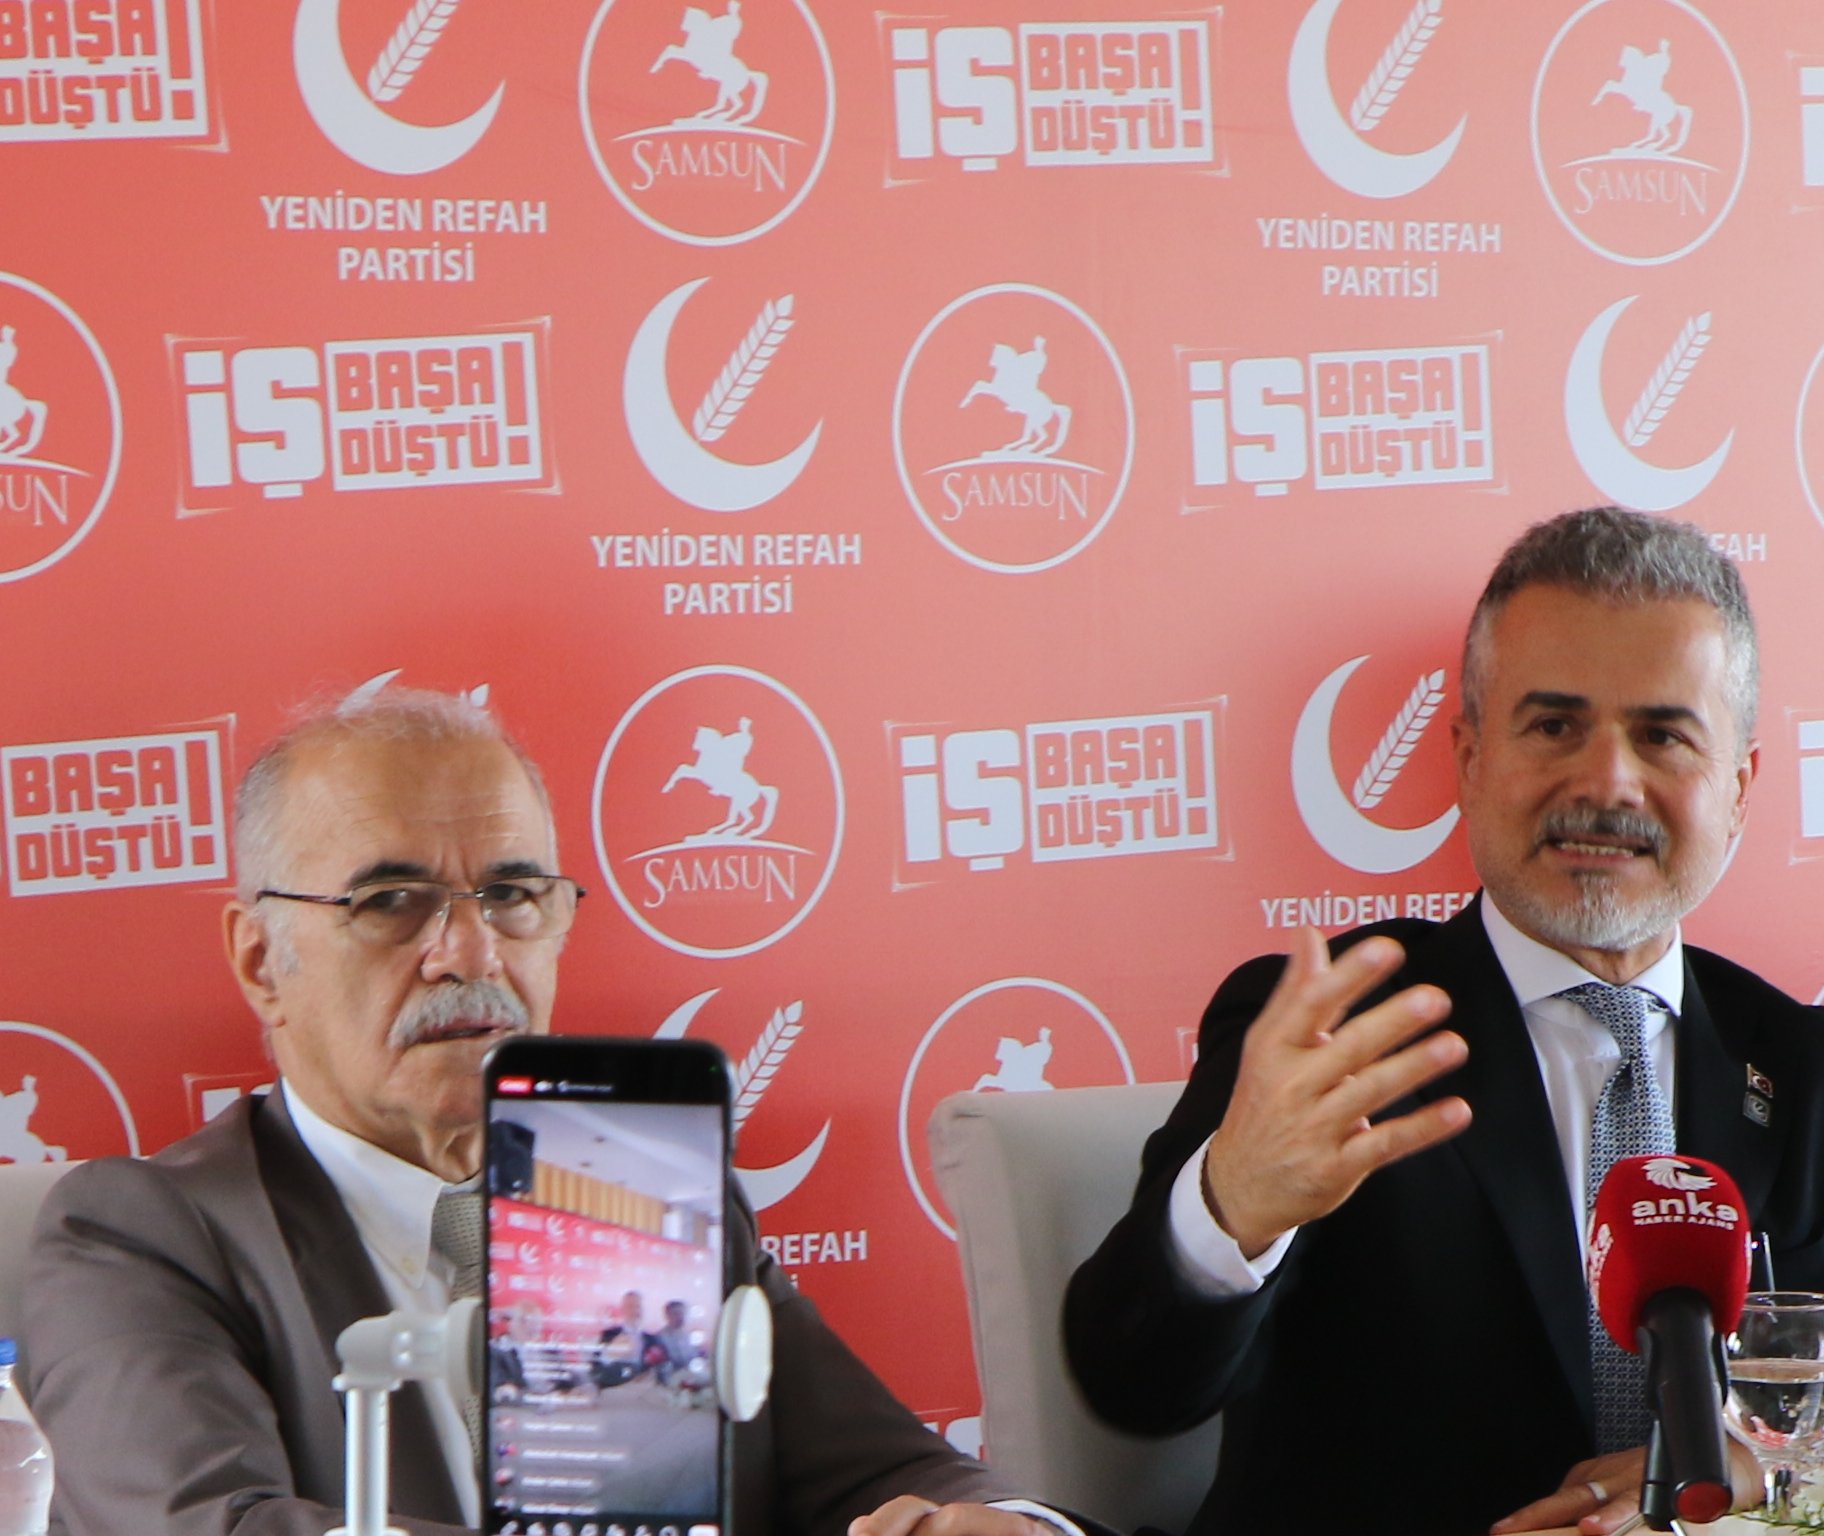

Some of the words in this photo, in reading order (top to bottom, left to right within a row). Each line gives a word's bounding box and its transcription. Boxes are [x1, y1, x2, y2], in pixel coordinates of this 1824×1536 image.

[1027, 33, 1172, 96] BAŞA
[893, 27, 1017, 171] İŞ
[632, 139, 787, 193] SAMSUN
[1574, 166, 1708, 217] SAMSUN
[261, 190, 422, 231] YENİDEN
[433, 199, 547, 233] REFAH
[1257, 213, 1395, 250] YENİDEN
[1404, 222, 1501, 252] REFAH
[339, 241, 474, 281] PARTİSİ
[1323, 261, 1438, 297] PARTİSİ
[335, 347, 495, 414] BAŞA
[1317, 357, 1454, 419] BAŞA
[185, 347, 325, 498] İŞ
[1190, 358, 1307, 496] İŞ
[942, 472, 1088, 521] SAMSUN
[591, 528, 744, 567] YENİDEN
[754, 534, 861, 565] REFAH
[1708, 532, 1768, 562] FAH
[665, 578, 792, 614] PARTİSİ
[10, 747, 178, 817] BAŞA
[1035, 725, 1177, 788] BAŞA
[901, 730, 1024, 870] İŞ
[642, 856, 797, 909] SAMSUN
[1261, 889, 1397, 928] YENİDEN
[1405, 892, 1475, 923] REF
[1632, 1191, 1739, 1222] anka
[760, 1229, 868, 1267] REFAH
